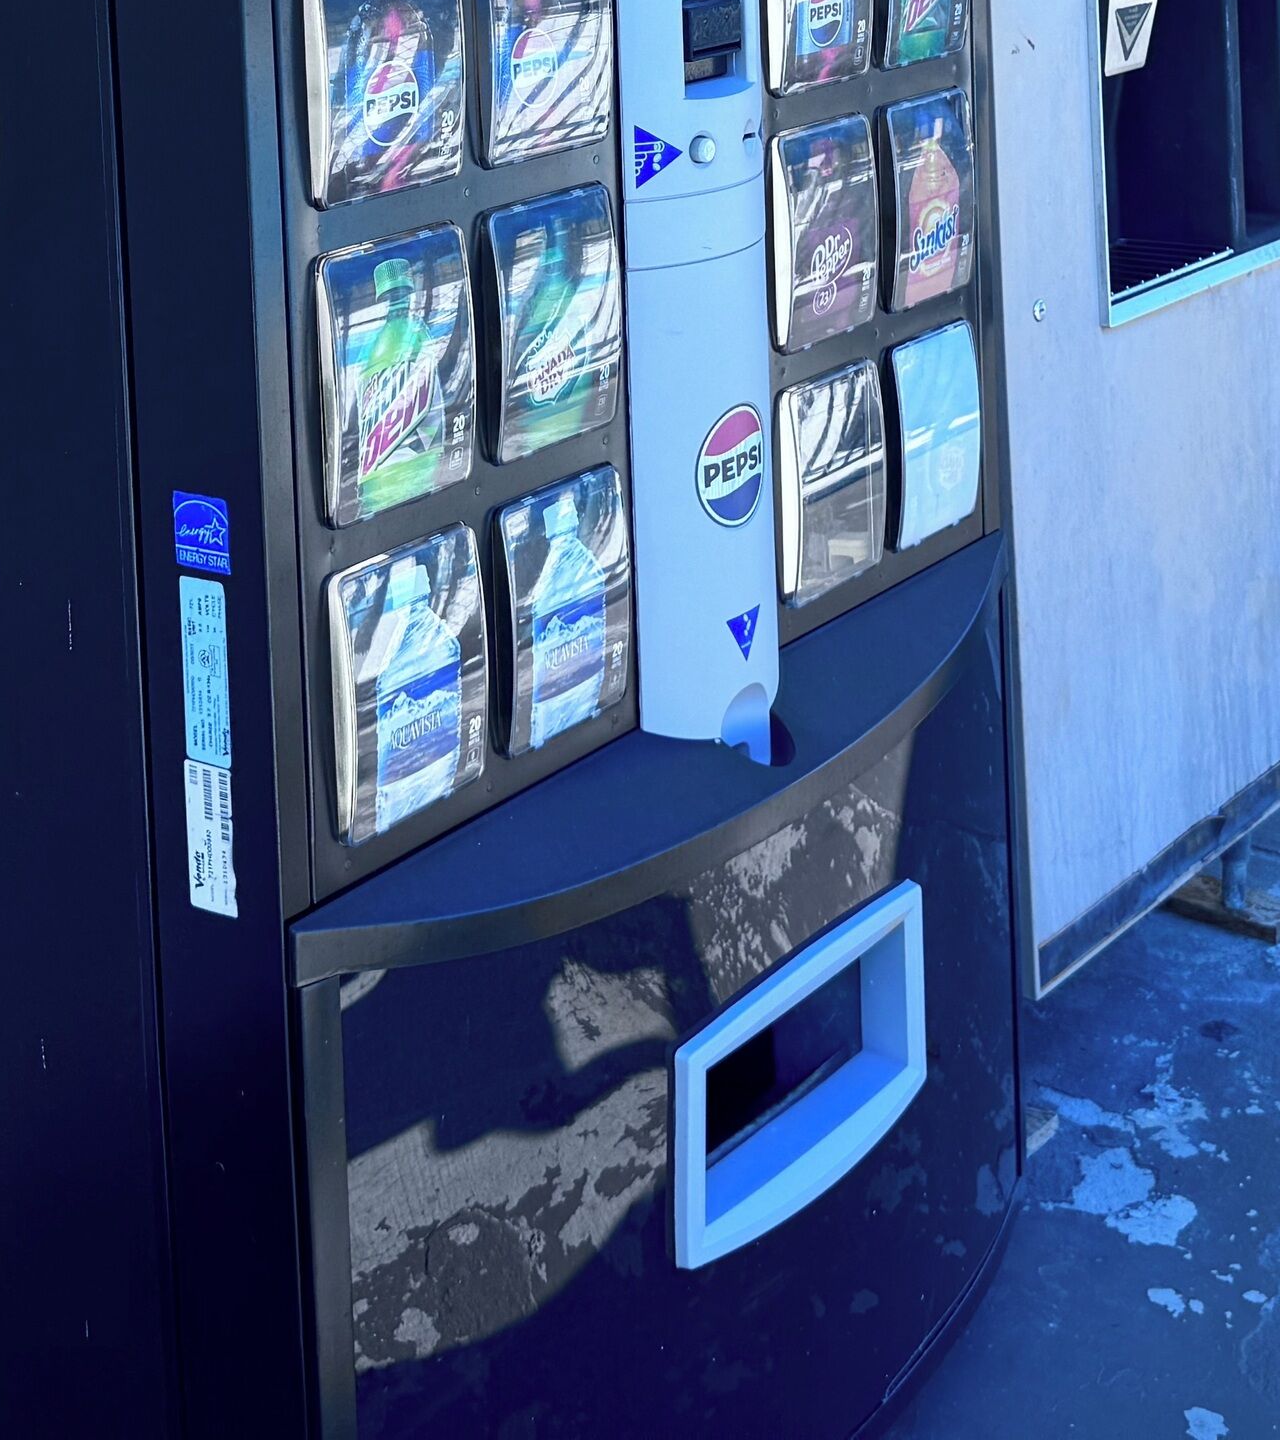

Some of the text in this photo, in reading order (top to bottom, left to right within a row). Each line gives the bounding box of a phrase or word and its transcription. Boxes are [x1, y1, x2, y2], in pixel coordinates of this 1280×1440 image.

[809, 2, 842, 23] PEPSI
[513, 56, 556, 80] PEPSI
[366, 90, 416, 118] PEPSI
[441, 110, 454, 127] 20
[825, 234, 840, 260] Dr
[909, 205, 959, 273] Sunkist
[811, 238, 850, 284] Pepper
[820, 291, 829, 306] 23
[600, 364, 610, 380] 20
[453, 415, 465, 433] 20
[703, 440, 762, 489] PEPSI
[179, 549, 229, 568] ENERGY STAR
[612, 641, 623, 657] 20
[390, 709, 442, 749] AQUAVISTA
[469, 715, 481, 734] 20
[192, 849, 205, 890] Vendo
